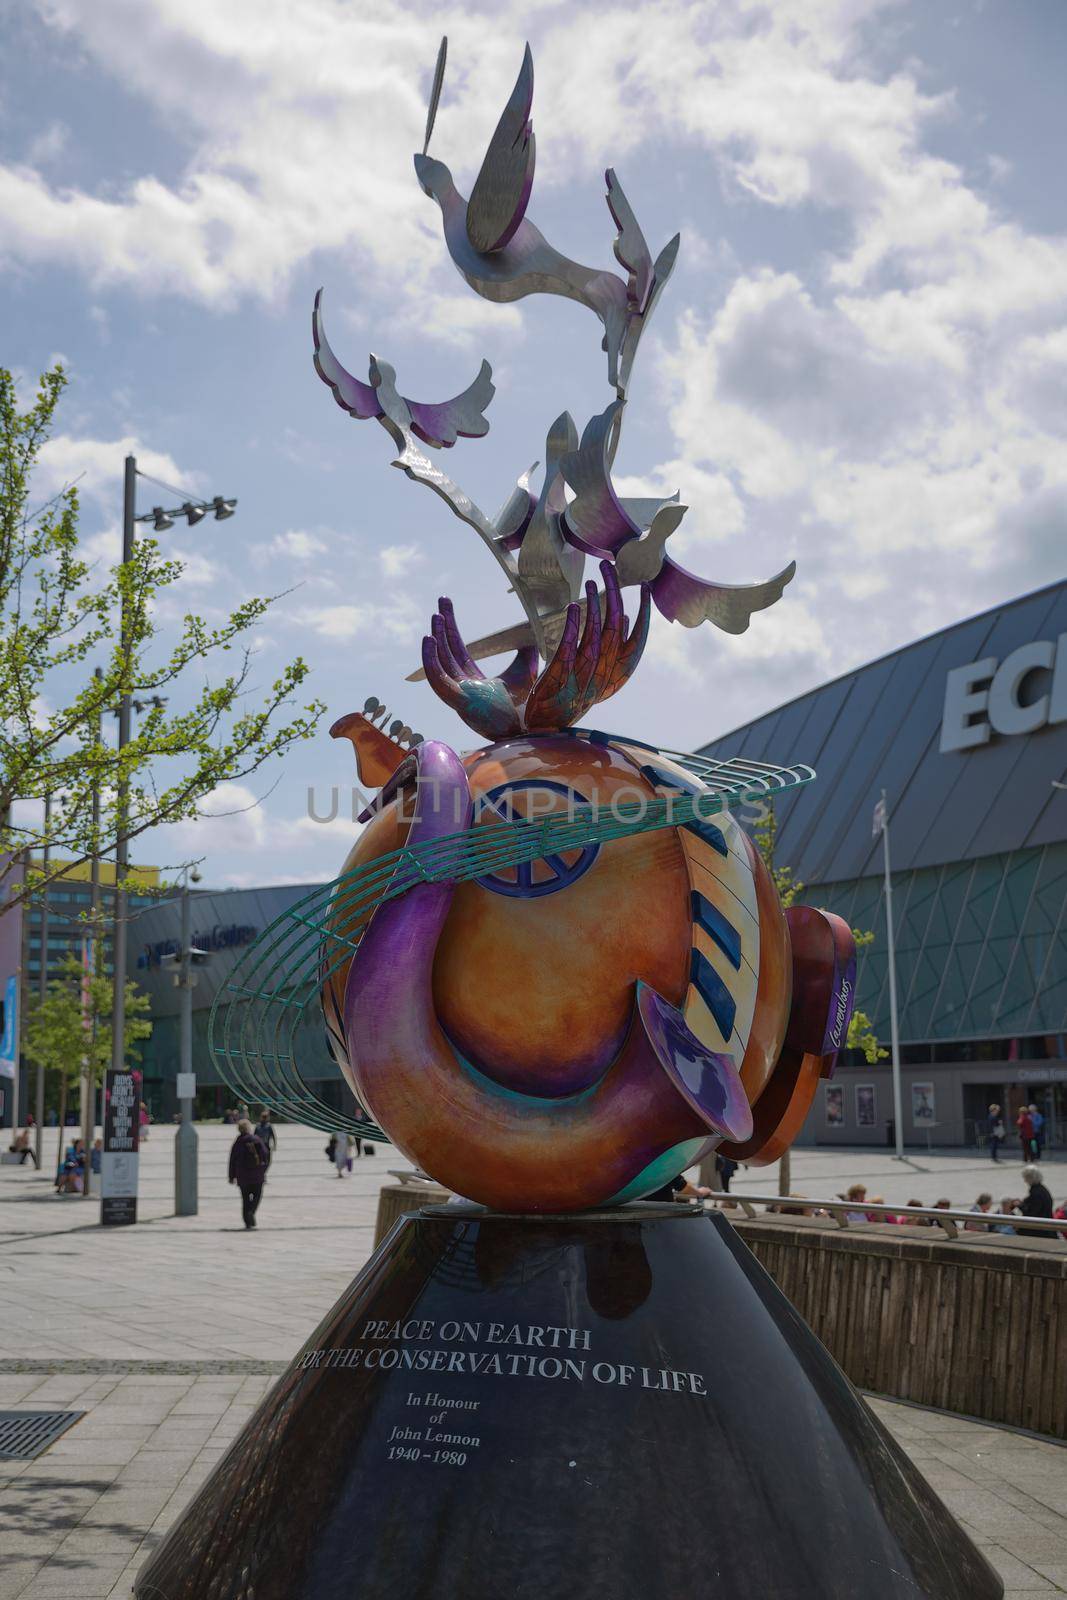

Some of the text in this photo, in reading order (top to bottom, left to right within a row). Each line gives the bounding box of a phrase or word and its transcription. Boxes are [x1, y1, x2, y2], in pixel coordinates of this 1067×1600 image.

[360, 1319, 592, 1351] PEACE ON EARTH
[324, 1349, 363, 1369] THE
[364, 1348, 587, 1382] CONSERVATION
[591, 1362, 636, 1386] OF
[640, 1367, 708, 1397] LIFE
[406, 1392, 480, 1411] In Honour
[429, 1411, 446, 1425] of
[387, 1426, 480, 1448] John Lennon
